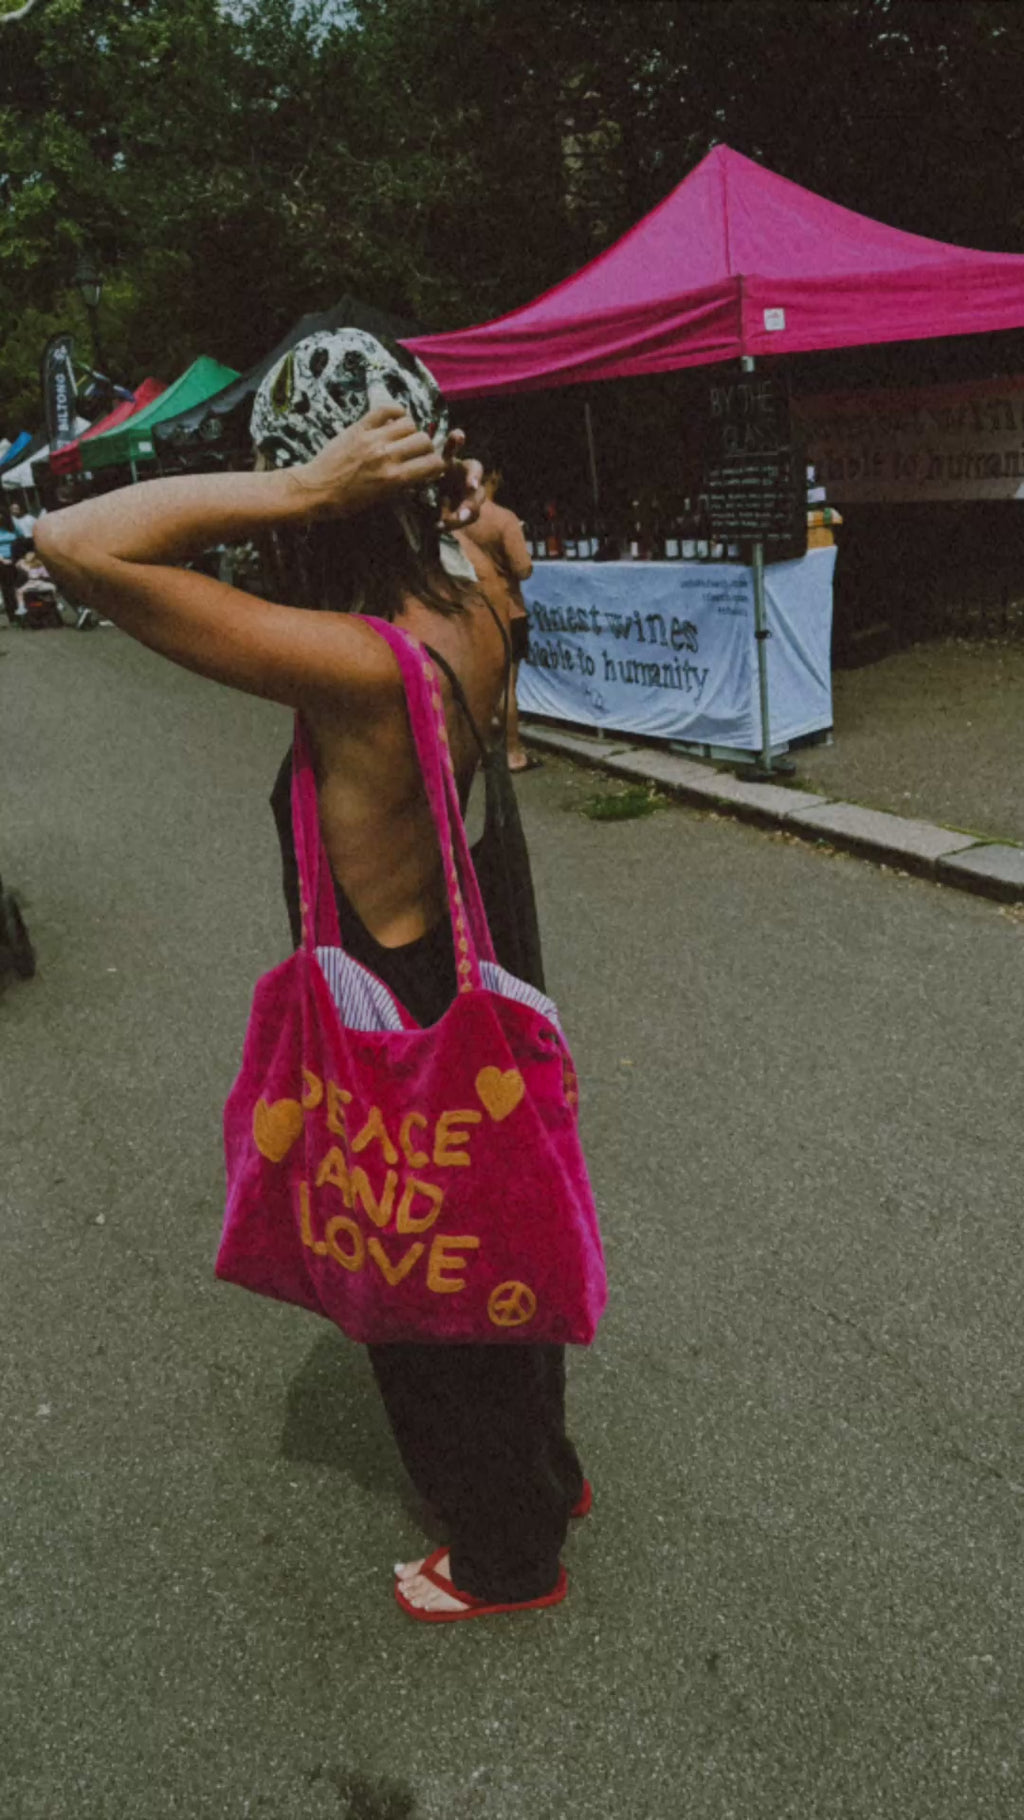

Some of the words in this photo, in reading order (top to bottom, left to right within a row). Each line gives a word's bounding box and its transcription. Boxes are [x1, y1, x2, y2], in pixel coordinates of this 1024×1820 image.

[576, 646, 595, 676] to
[601, 649, 708, 702] humanity
[602, 610, 698, 653] wines
[302, 1068, 482, 1168] PEACE
[316, 1146, 444, 1234] AND
[301, 1181, 480, 1293] LOVE
